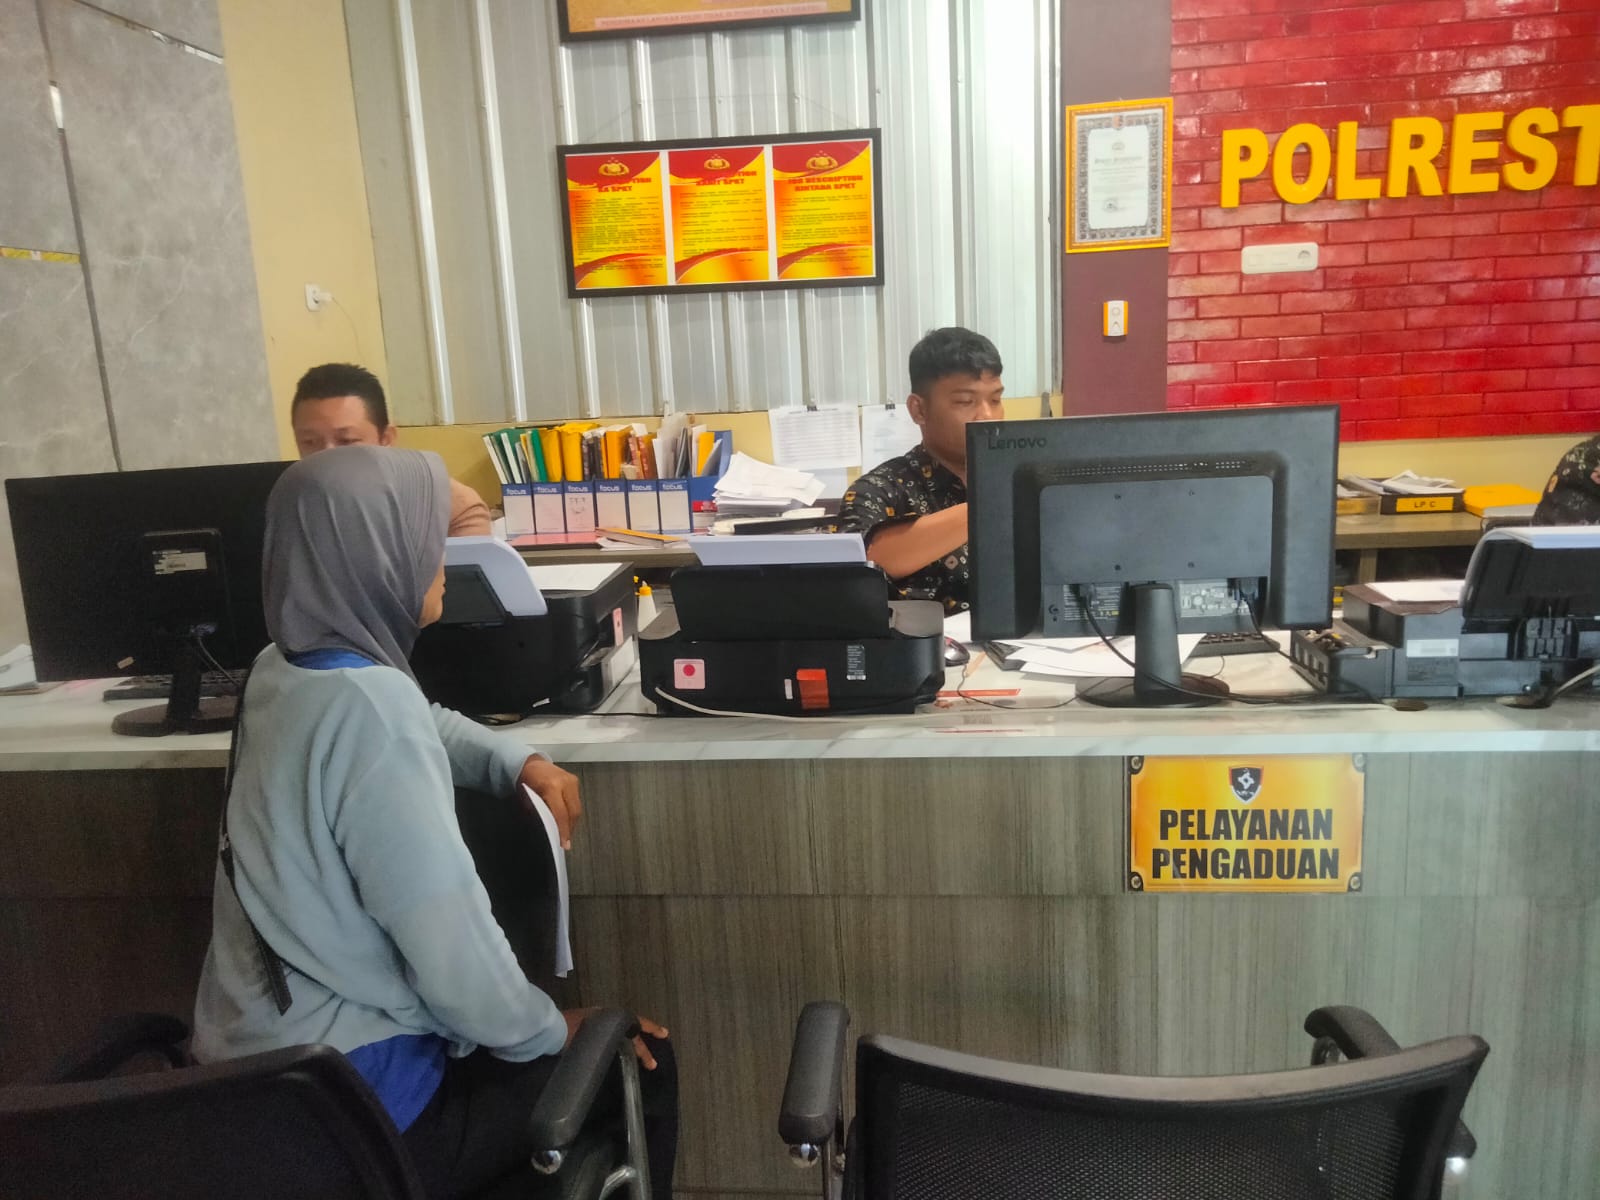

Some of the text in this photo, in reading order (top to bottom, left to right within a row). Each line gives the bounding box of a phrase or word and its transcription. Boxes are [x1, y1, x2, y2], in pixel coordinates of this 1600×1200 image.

[806, 175, 863, 183] DESCRIPTION
[988, 437, 1047, 450] Lenovo
[507, 487, 527, 495] focus
[1159, 808, 1333, 841] PELAYANAN
[1152, 847, 1339, 880] PENGADUAN
